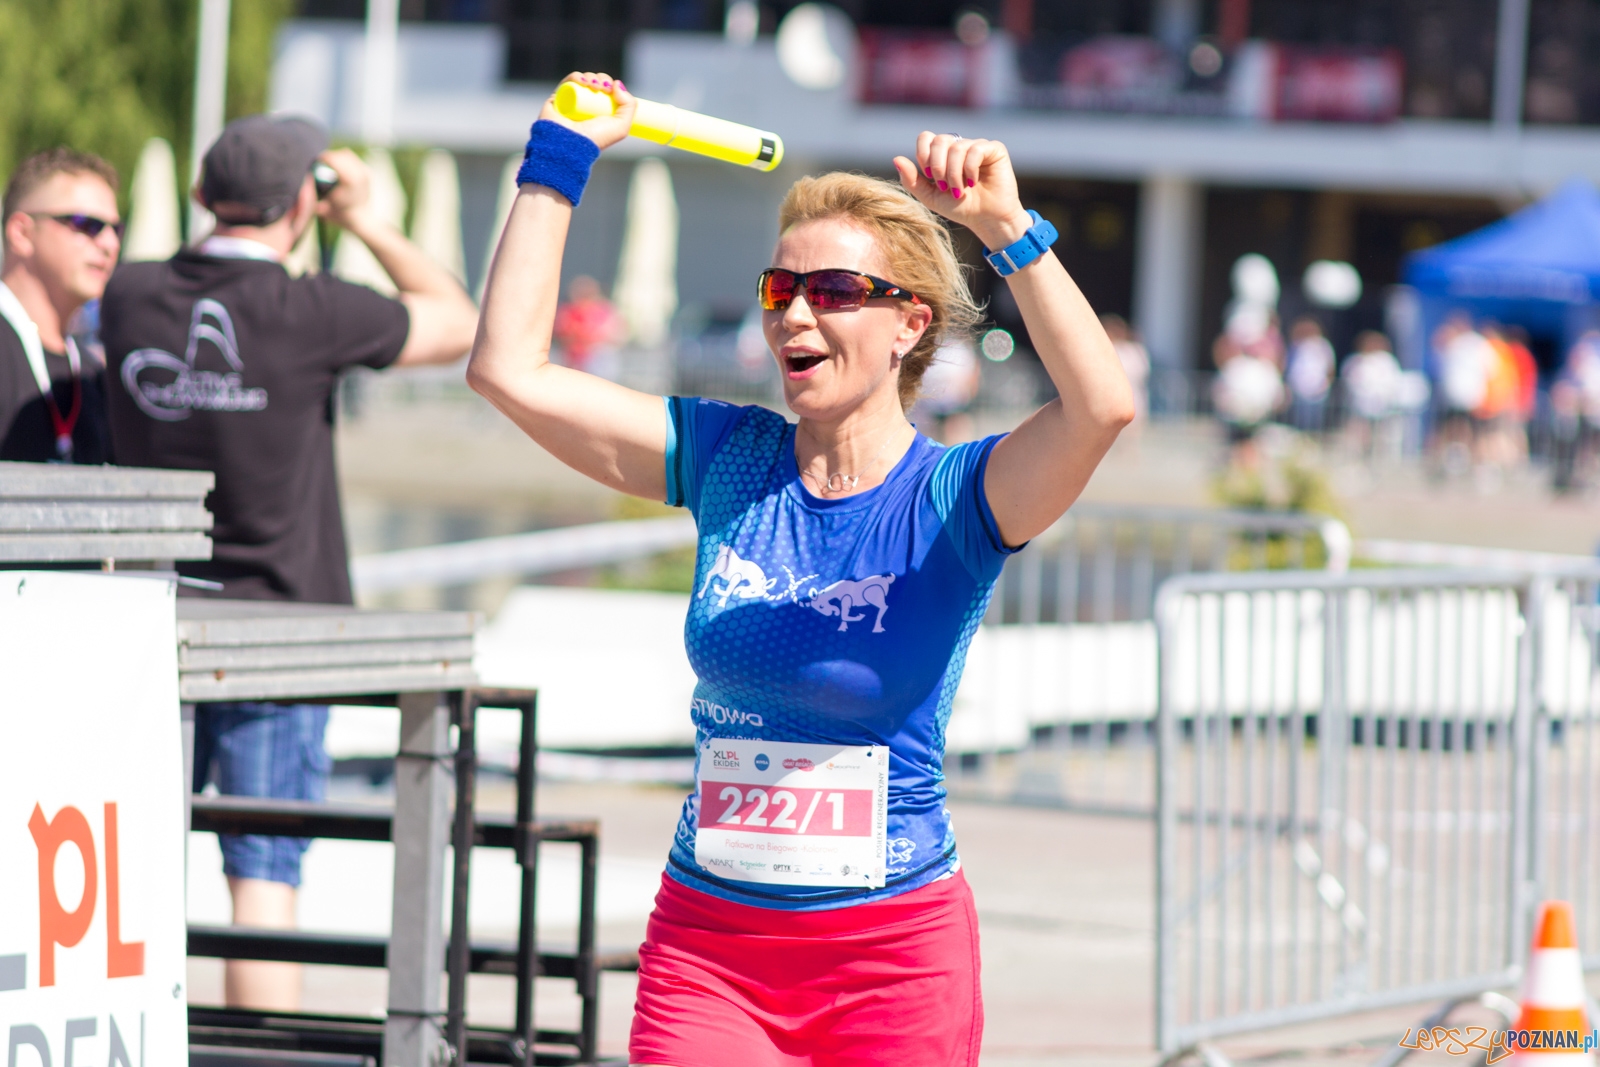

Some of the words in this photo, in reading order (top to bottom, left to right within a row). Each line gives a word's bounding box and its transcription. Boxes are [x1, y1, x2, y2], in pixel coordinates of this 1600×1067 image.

[713, 759, 740, 768] EKIDEN
[716, 786, 845, 834] 222/1
[877, 772, 885, 829] REGENERACYJNY
[708, 858, 735, 868] APART
